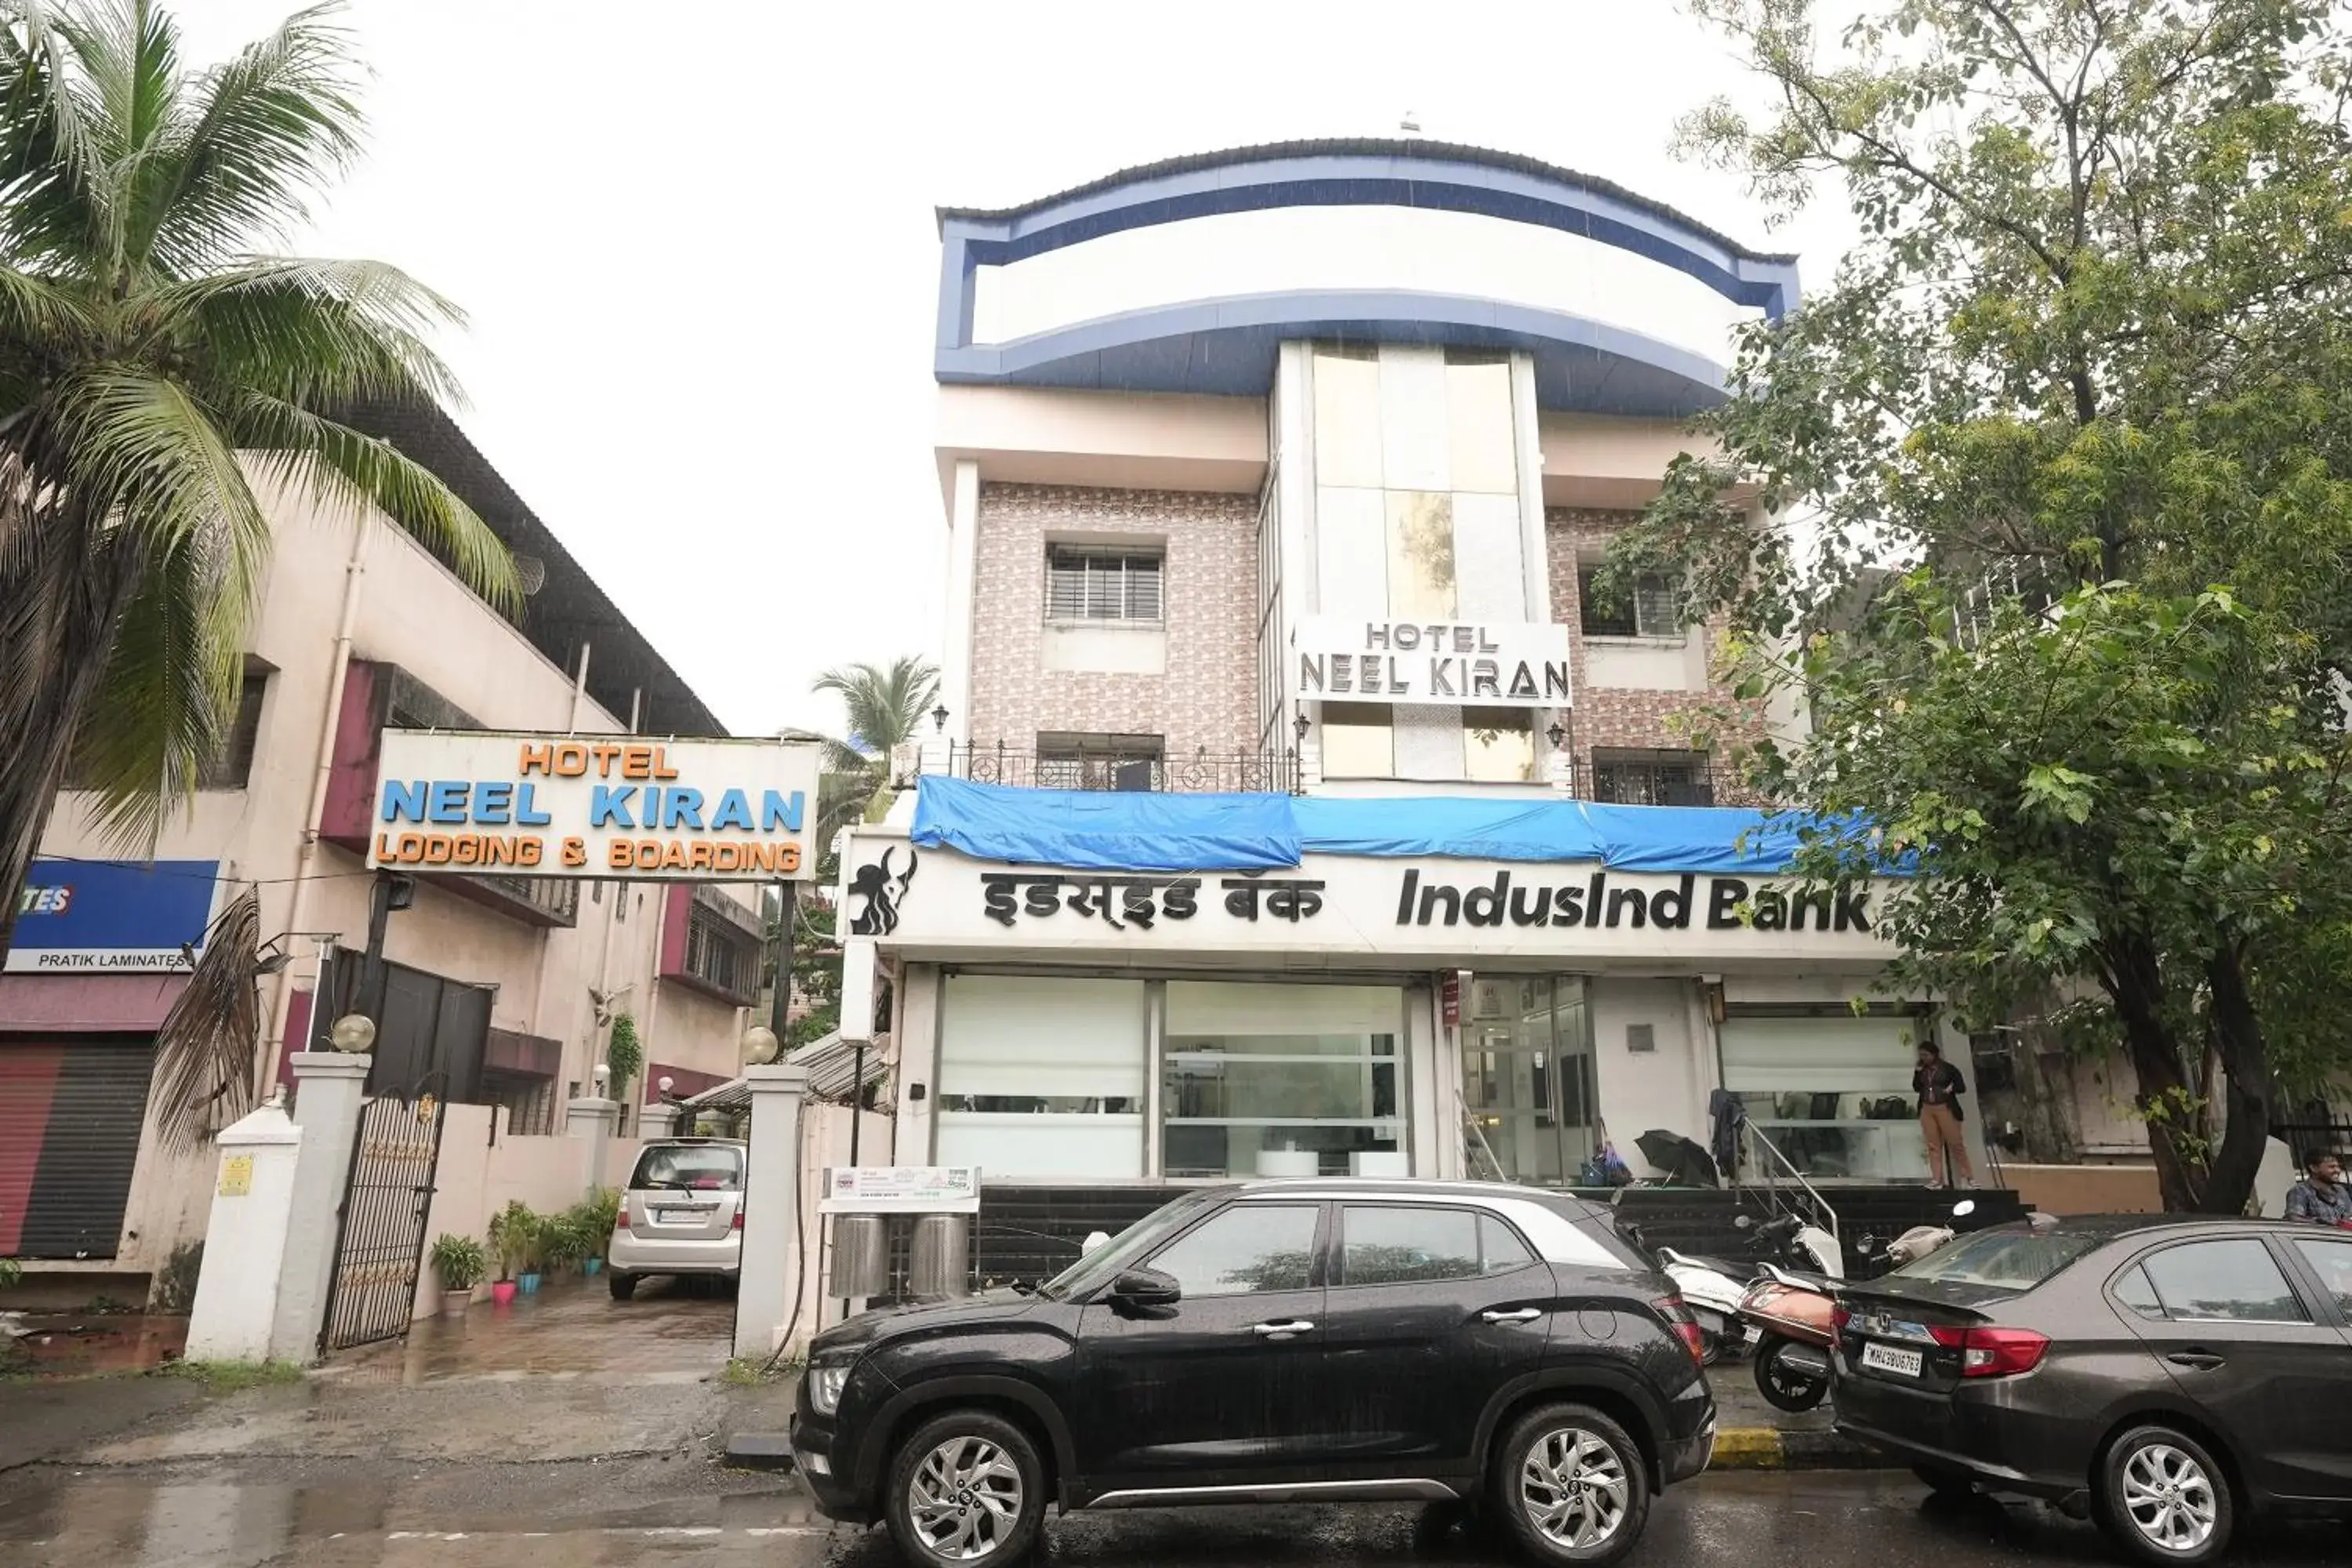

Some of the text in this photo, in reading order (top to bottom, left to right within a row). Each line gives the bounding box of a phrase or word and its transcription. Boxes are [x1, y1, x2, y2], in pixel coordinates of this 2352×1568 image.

[1367, 623, 1499, 652] HOTEL
[1300, 653, 1569, 699] NEEL KIRAN
[520, 745, 678, 778] HOTEL
[383, 780, 805, 832] NEEL KIRAN
[376, 833, 801, 872] LODGING & BOARDING
[1396, 869, 1872, 932] IndusInd Bank
[38, 954, 185, 967] PRATIK LAMINATES
